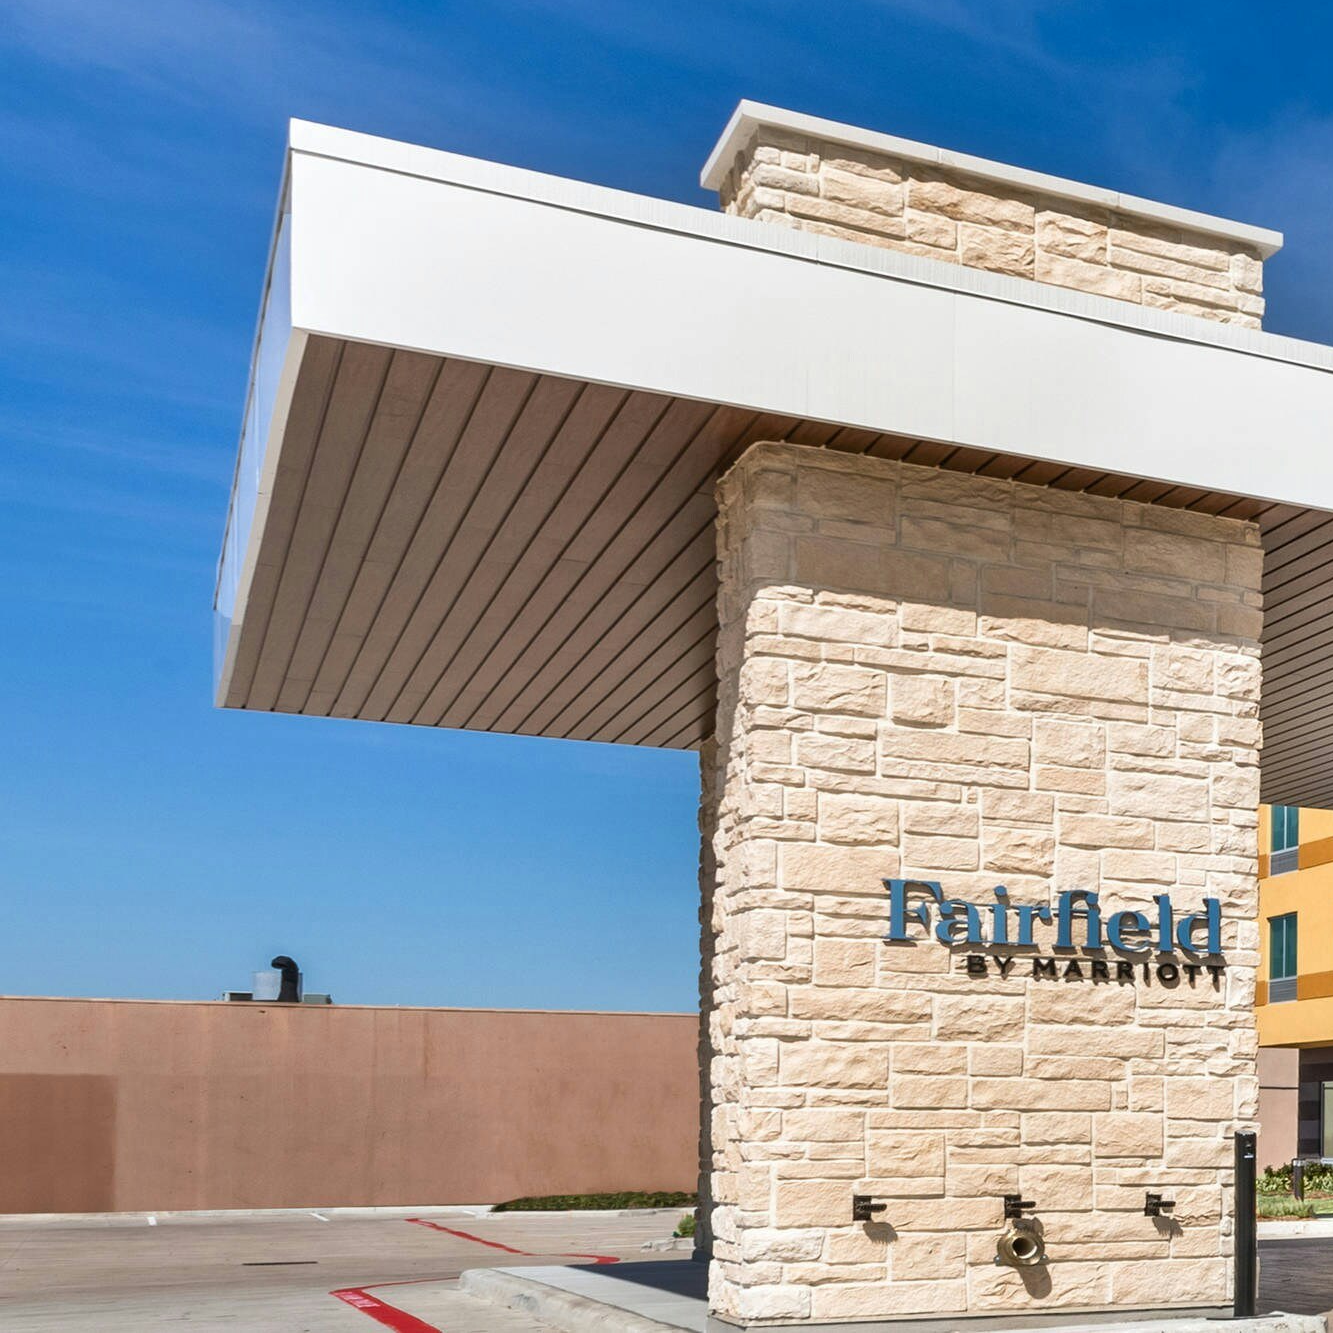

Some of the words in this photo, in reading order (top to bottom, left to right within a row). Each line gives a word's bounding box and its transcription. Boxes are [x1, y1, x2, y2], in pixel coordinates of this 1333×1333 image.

[881, 878, 1225, 955] Fairfield
[966, 954, 1015, 976] BY
[1033, 956, 1226, 985] MARRIOTT
